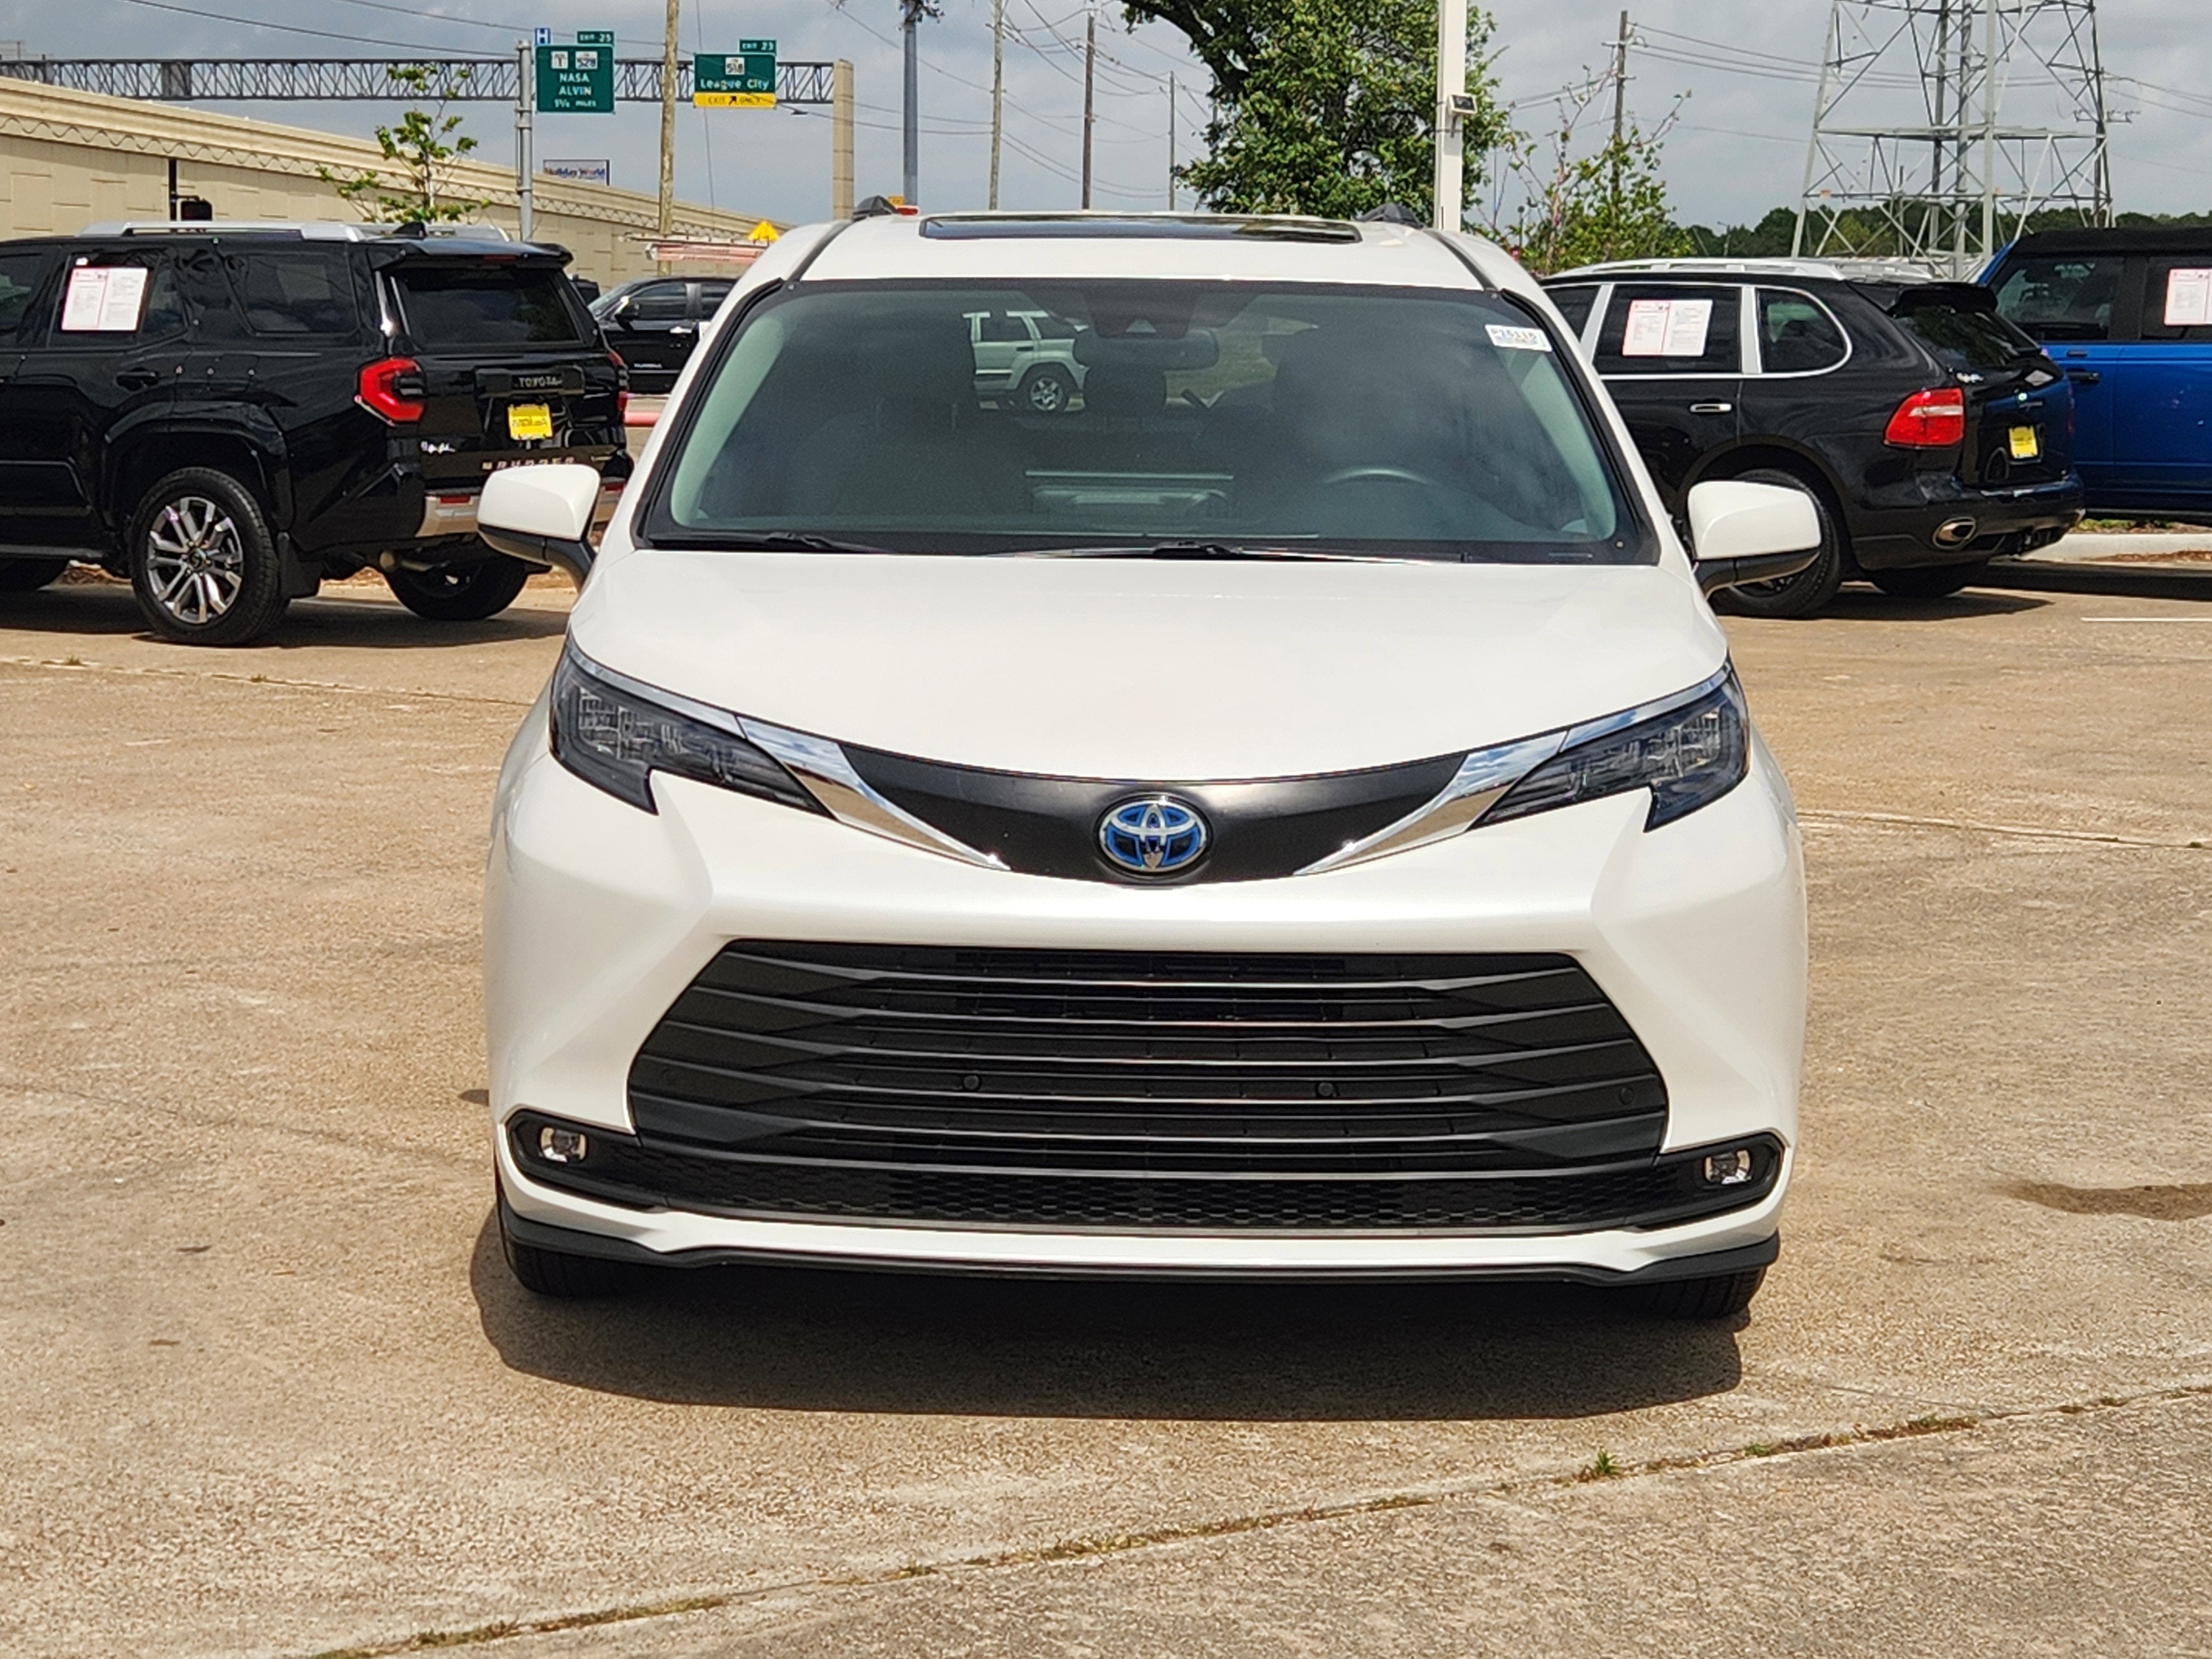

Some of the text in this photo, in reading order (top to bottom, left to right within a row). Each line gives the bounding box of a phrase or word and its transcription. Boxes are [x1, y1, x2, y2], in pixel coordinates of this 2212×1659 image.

[761, 41, 774, 51] 23
[726, 62, 744, 74] 518
[559, 72, 590, 82] NASA
[700, 78, 770, 91] League City
[558, 85, 592, 96] ALVIN
[518, 376, 562, 387] TOYOTA
